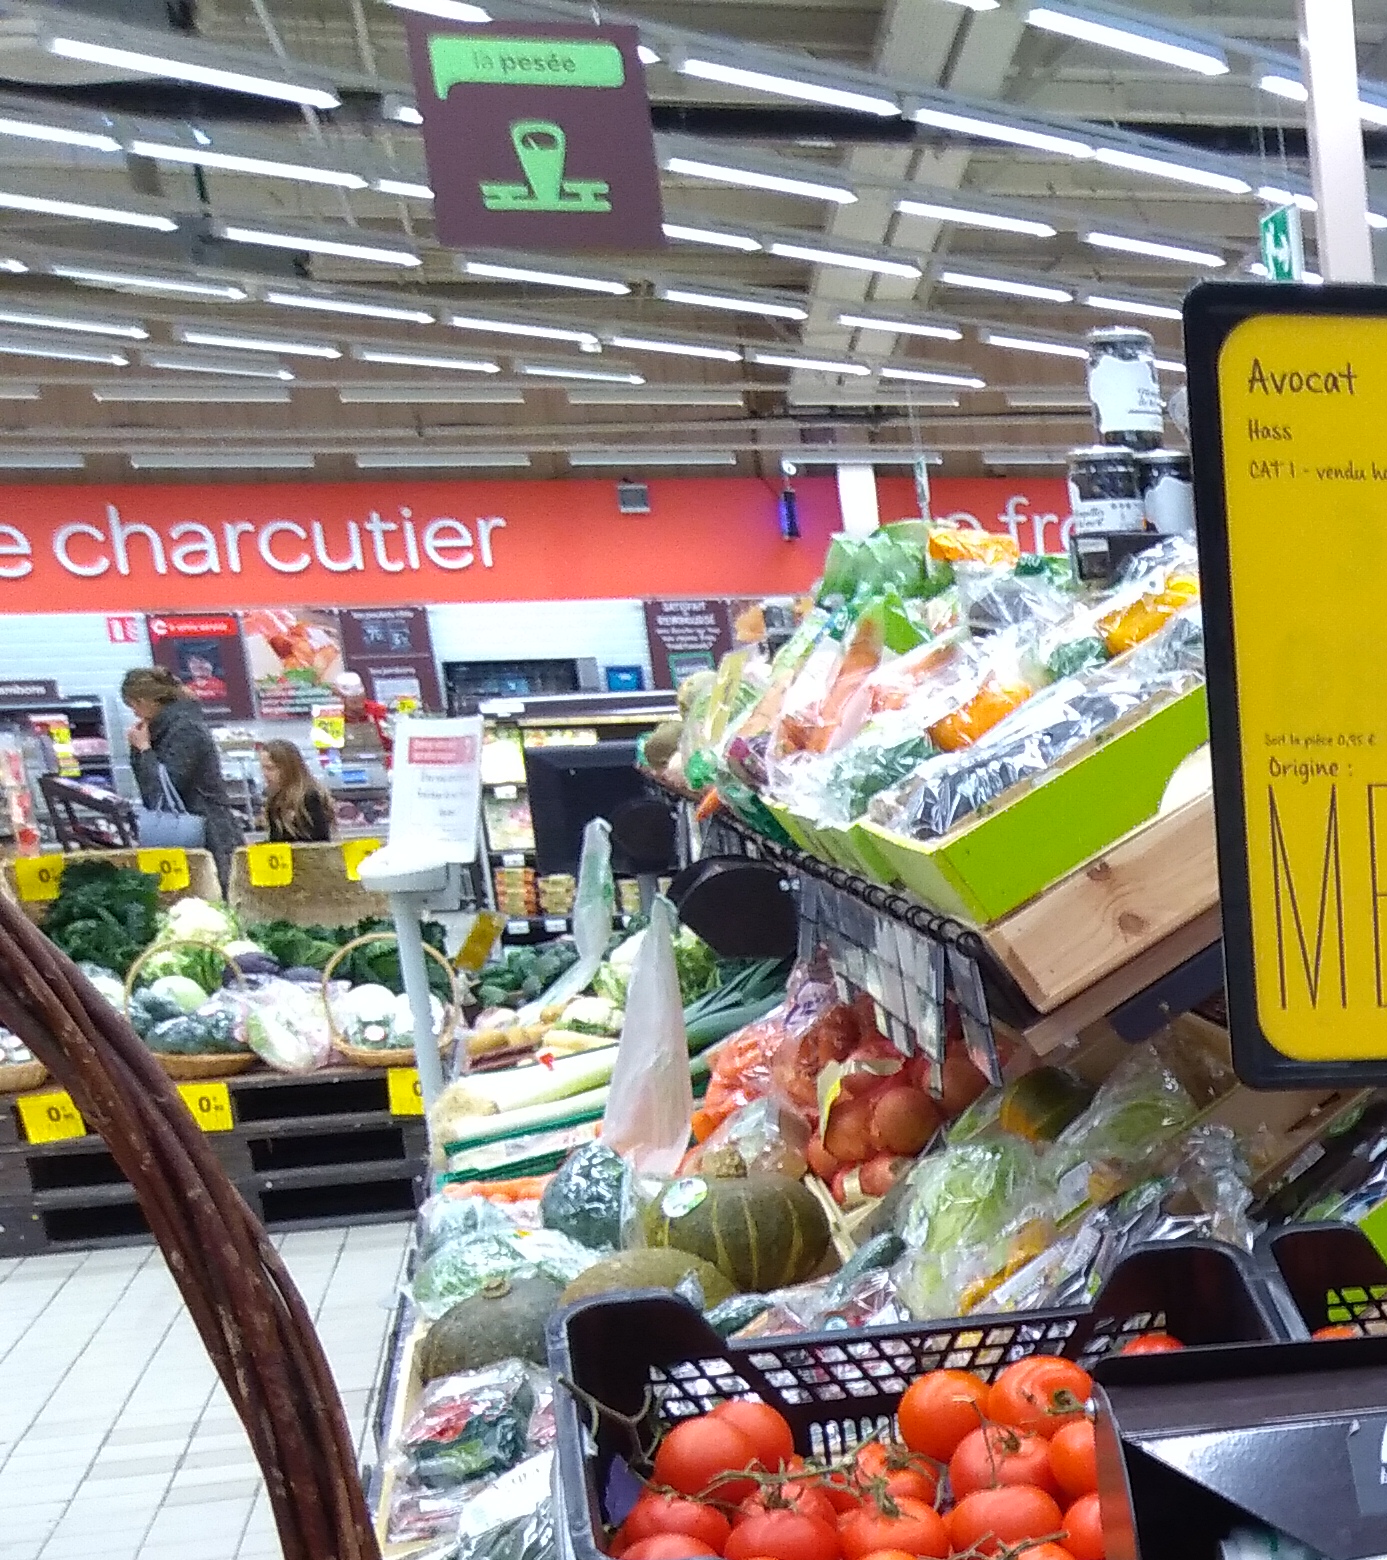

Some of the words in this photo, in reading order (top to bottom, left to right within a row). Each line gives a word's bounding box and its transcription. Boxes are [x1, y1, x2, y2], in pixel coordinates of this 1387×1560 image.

[473, 50, 494, 69] la
[501, 54, 576, 74] pesée
[1248, 358, 1358, 396] Avocat
[1248, 418, 1293, 442] Hass
[1250, 459, 1283, 479] CAT
[1316, 460, 1366, 481] vendu
[52, 503, 508, 578] charcutier
[1269, 756, 1339, 786] Origine
